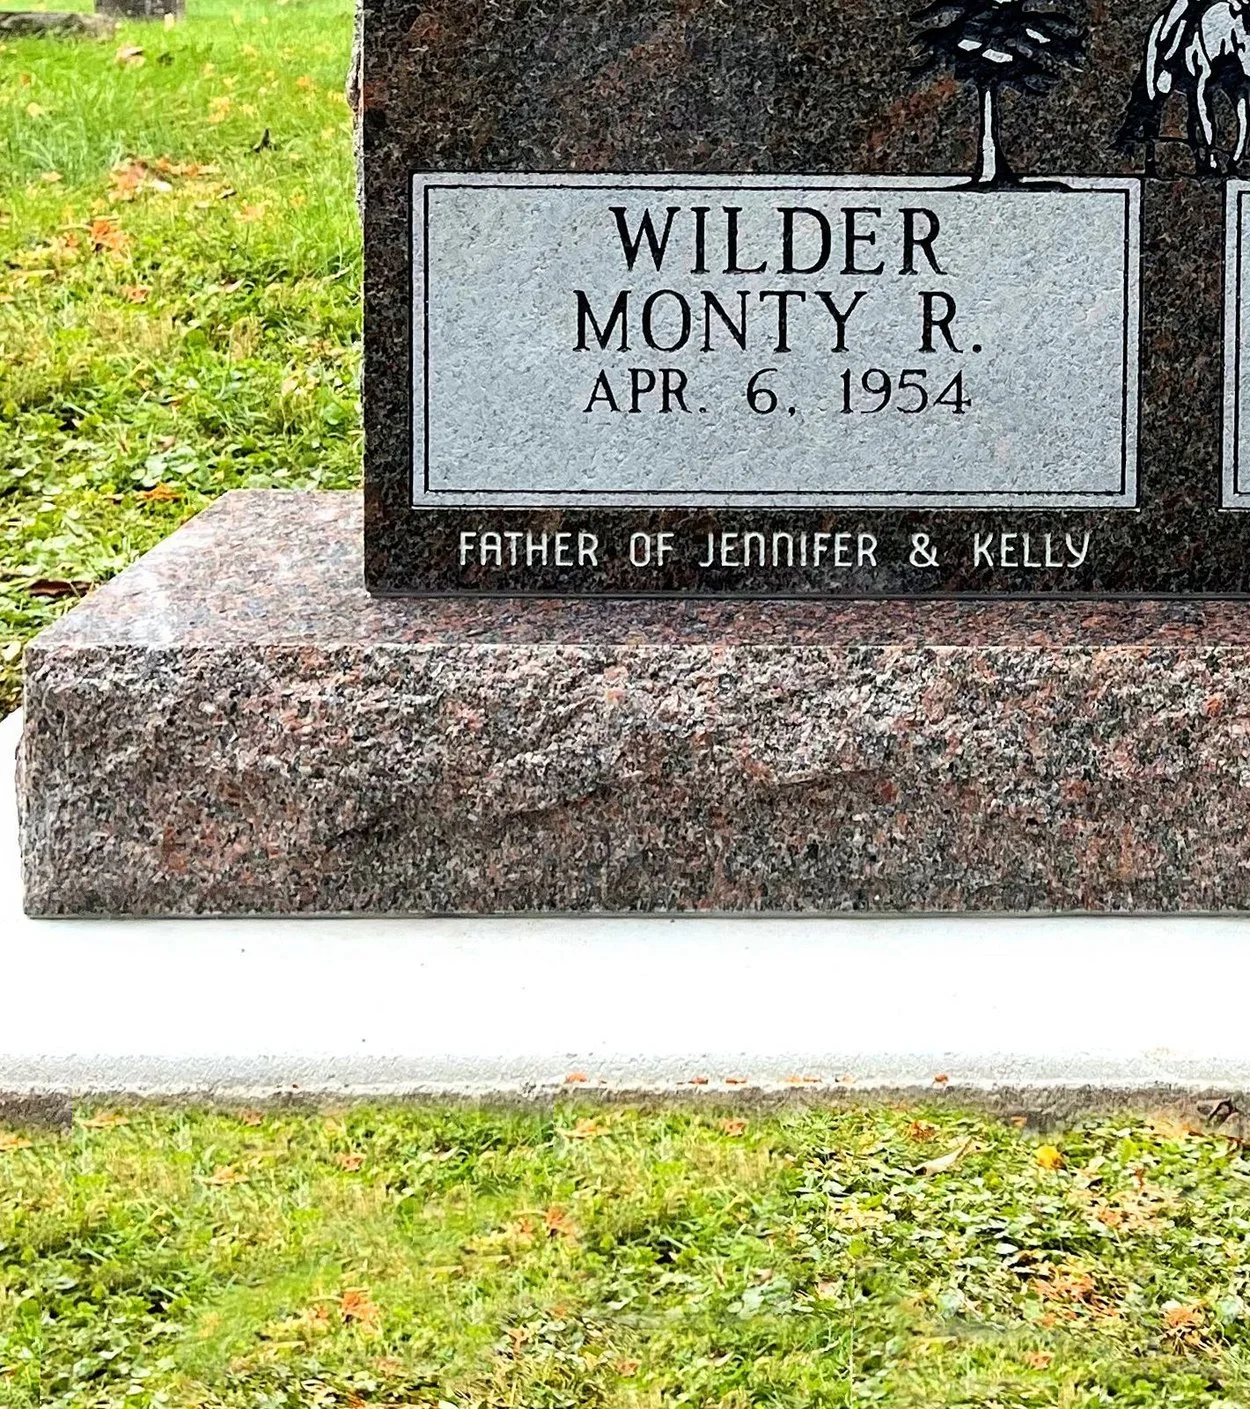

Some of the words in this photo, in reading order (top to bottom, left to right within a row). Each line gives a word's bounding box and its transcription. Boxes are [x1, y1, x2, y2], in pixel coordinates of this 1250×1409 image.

[609, 206, 946, 276] WILDER
[572, 290, 869, 353] MONTY
[919, 291, 984, 353] R.
[584, 368, 708, 414] APR.
[746, 368, 798, 417] 6,
[840, 368, 972, 414] 1954
[459, 533, 598, 567] FATHER
[629, 533, 674, 567] OF
[699, 533, 878, 568] JENNIFER
[909, 533, 938, 568] &
[974, 533, 1090, 567] KELLY
